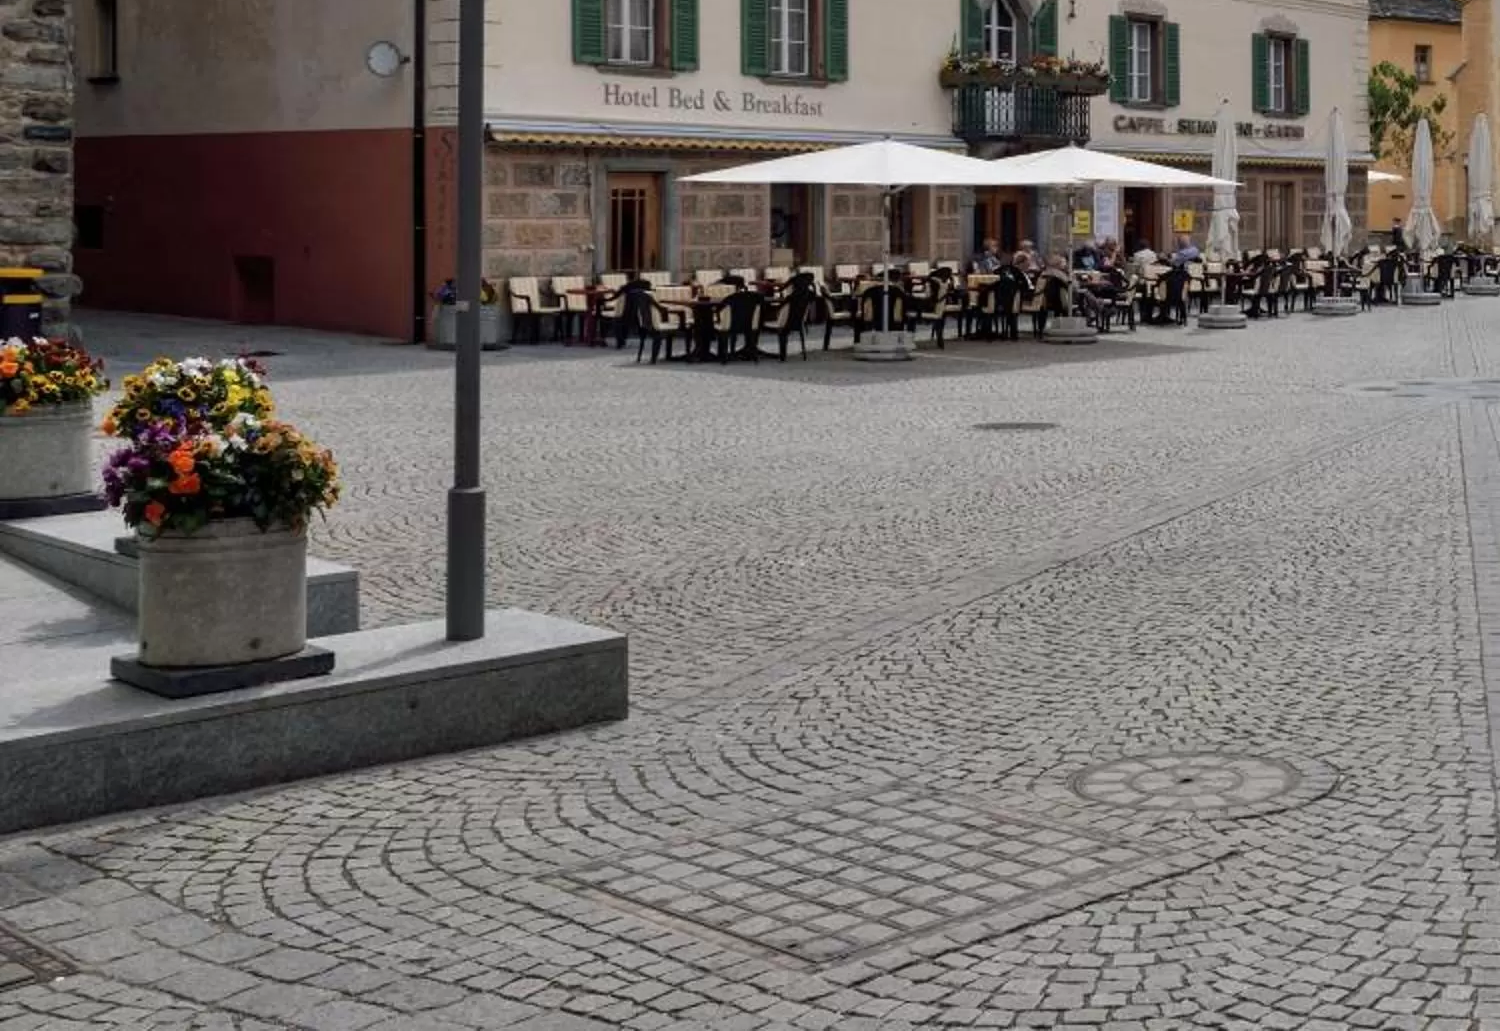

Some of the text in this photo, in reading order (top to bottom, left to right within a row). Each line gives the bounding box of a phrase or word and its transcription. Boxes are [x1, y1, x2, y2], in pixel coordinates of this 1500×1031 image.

[603, 83, 823, 116] Hotel Bed & Breakfast
